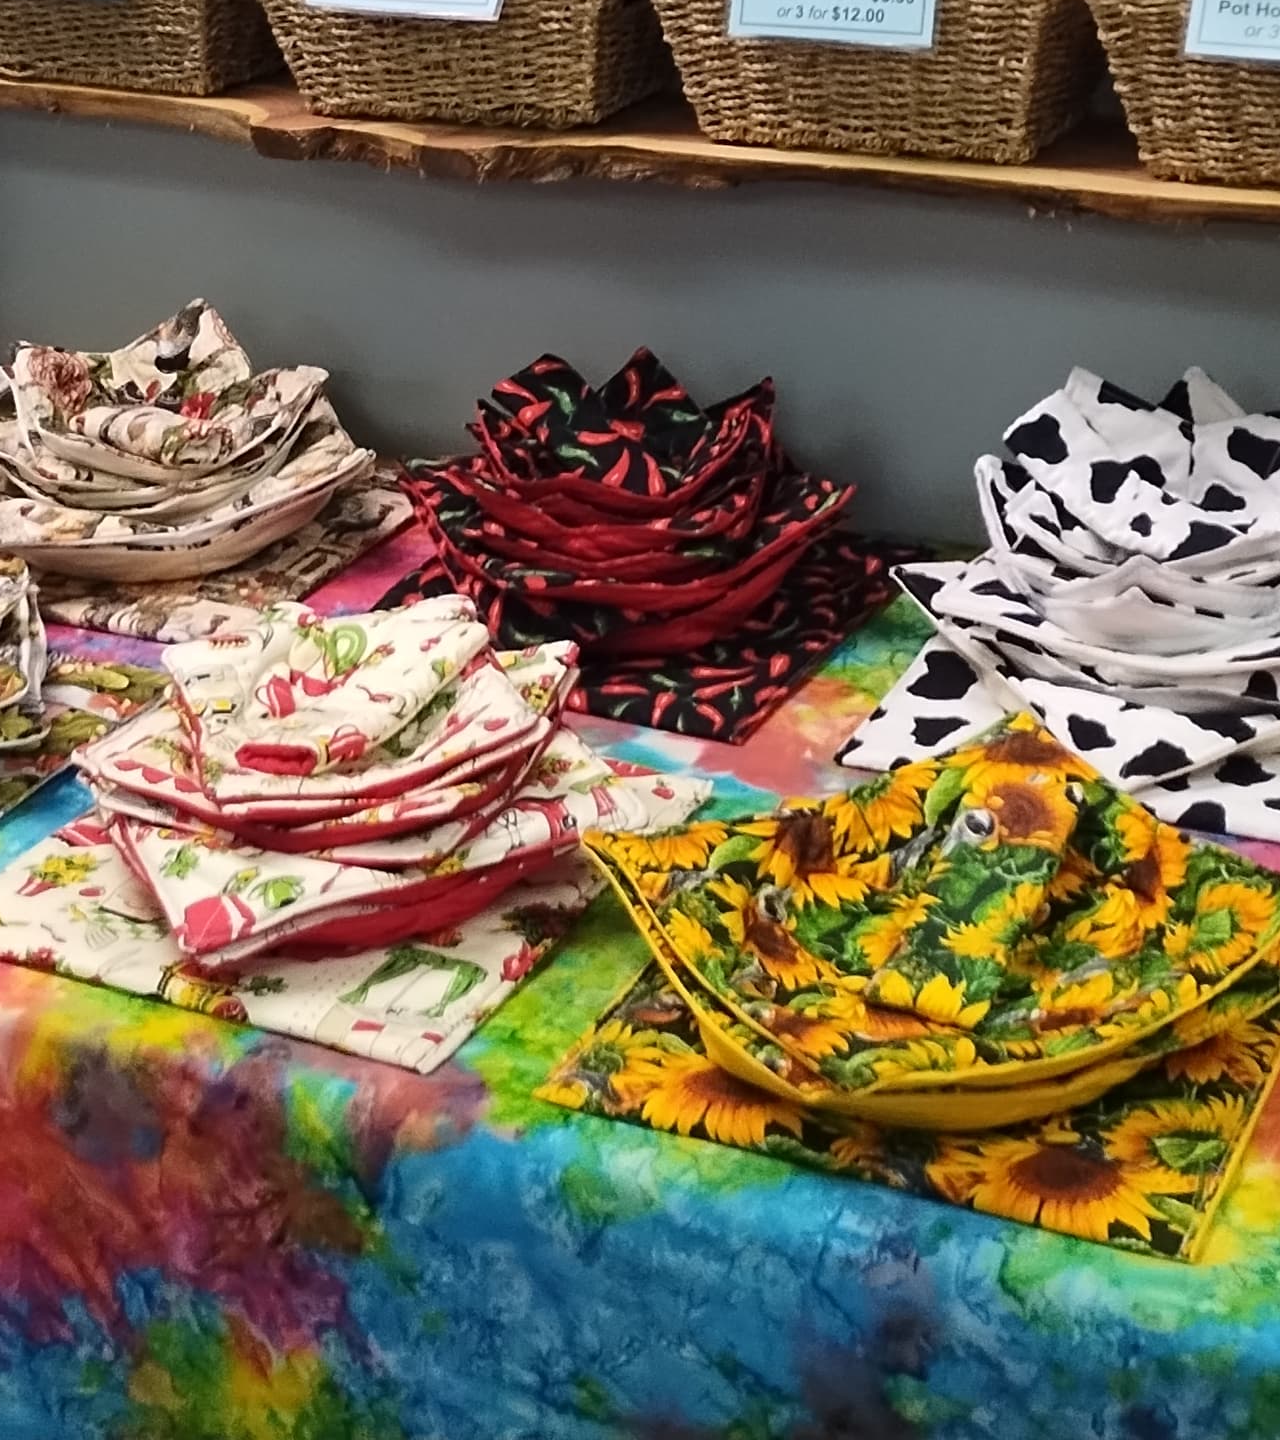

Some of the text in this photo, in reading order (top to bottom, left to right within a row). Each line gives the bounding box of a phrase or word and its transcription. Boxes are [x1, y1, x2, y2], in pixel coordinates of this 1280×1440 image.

[776, 4, 885, 23] or 3 for $12.00
[1217, 0, 1250, 17] Pot
[1244, 26, 1264, 38] or
[1267, 24, 1279, 39] 3
